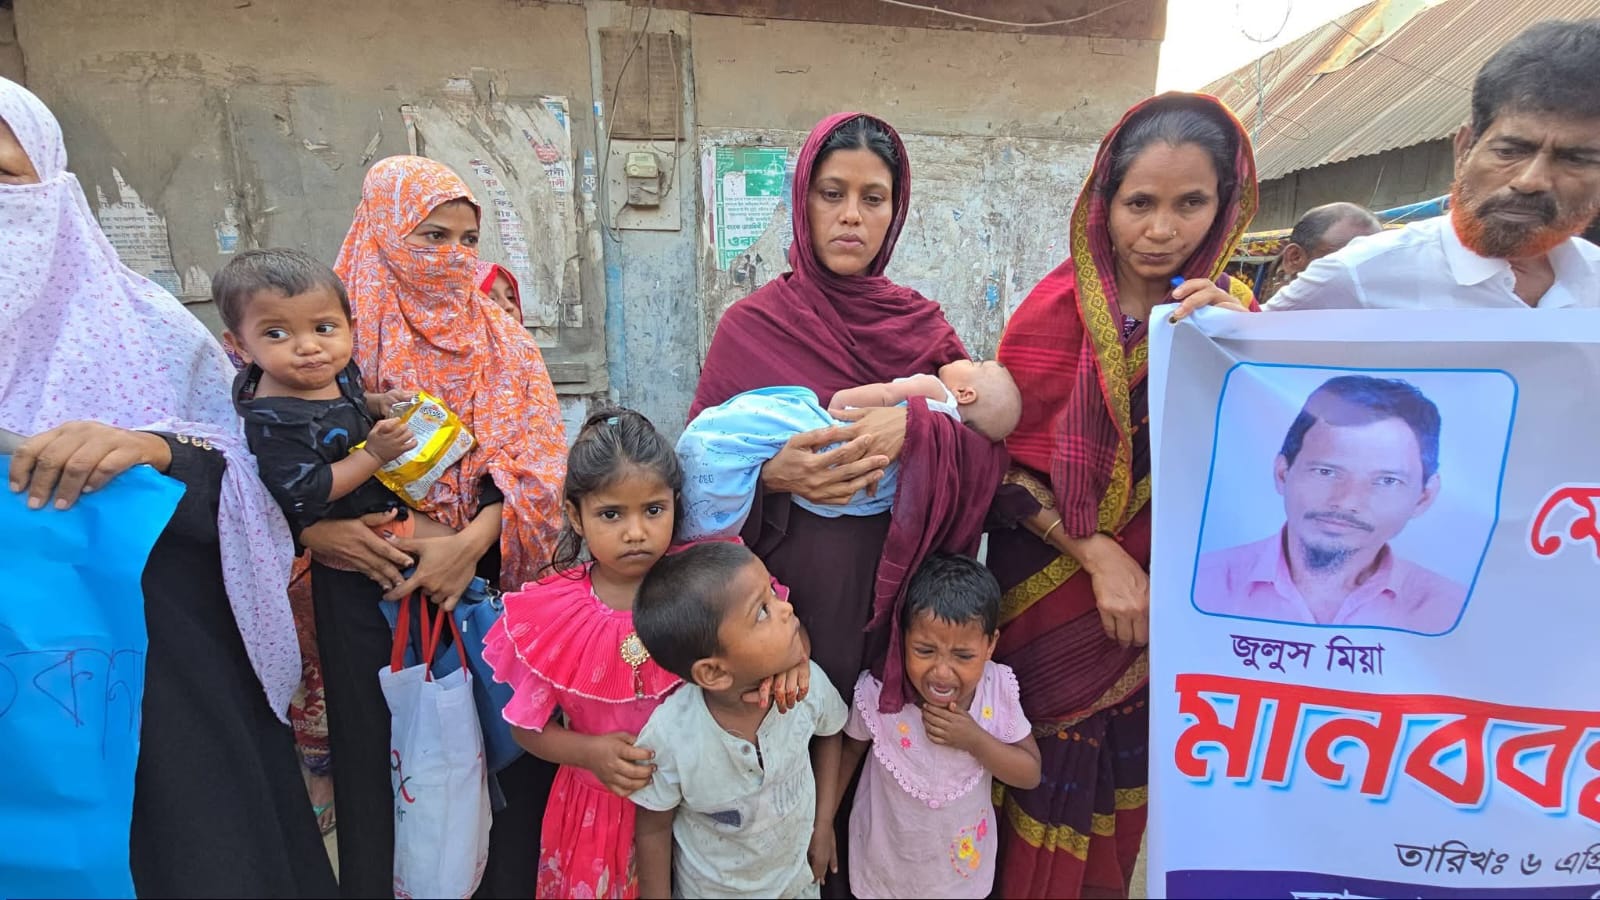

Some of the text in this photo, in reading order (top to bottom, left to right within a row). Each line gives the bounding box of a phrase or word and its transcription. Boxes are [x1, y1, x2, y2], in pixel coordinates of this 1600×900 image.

[1230, 634, 1385, 674] জুলুস মিয়া
[1520, 853, 1542, 876] ৬
